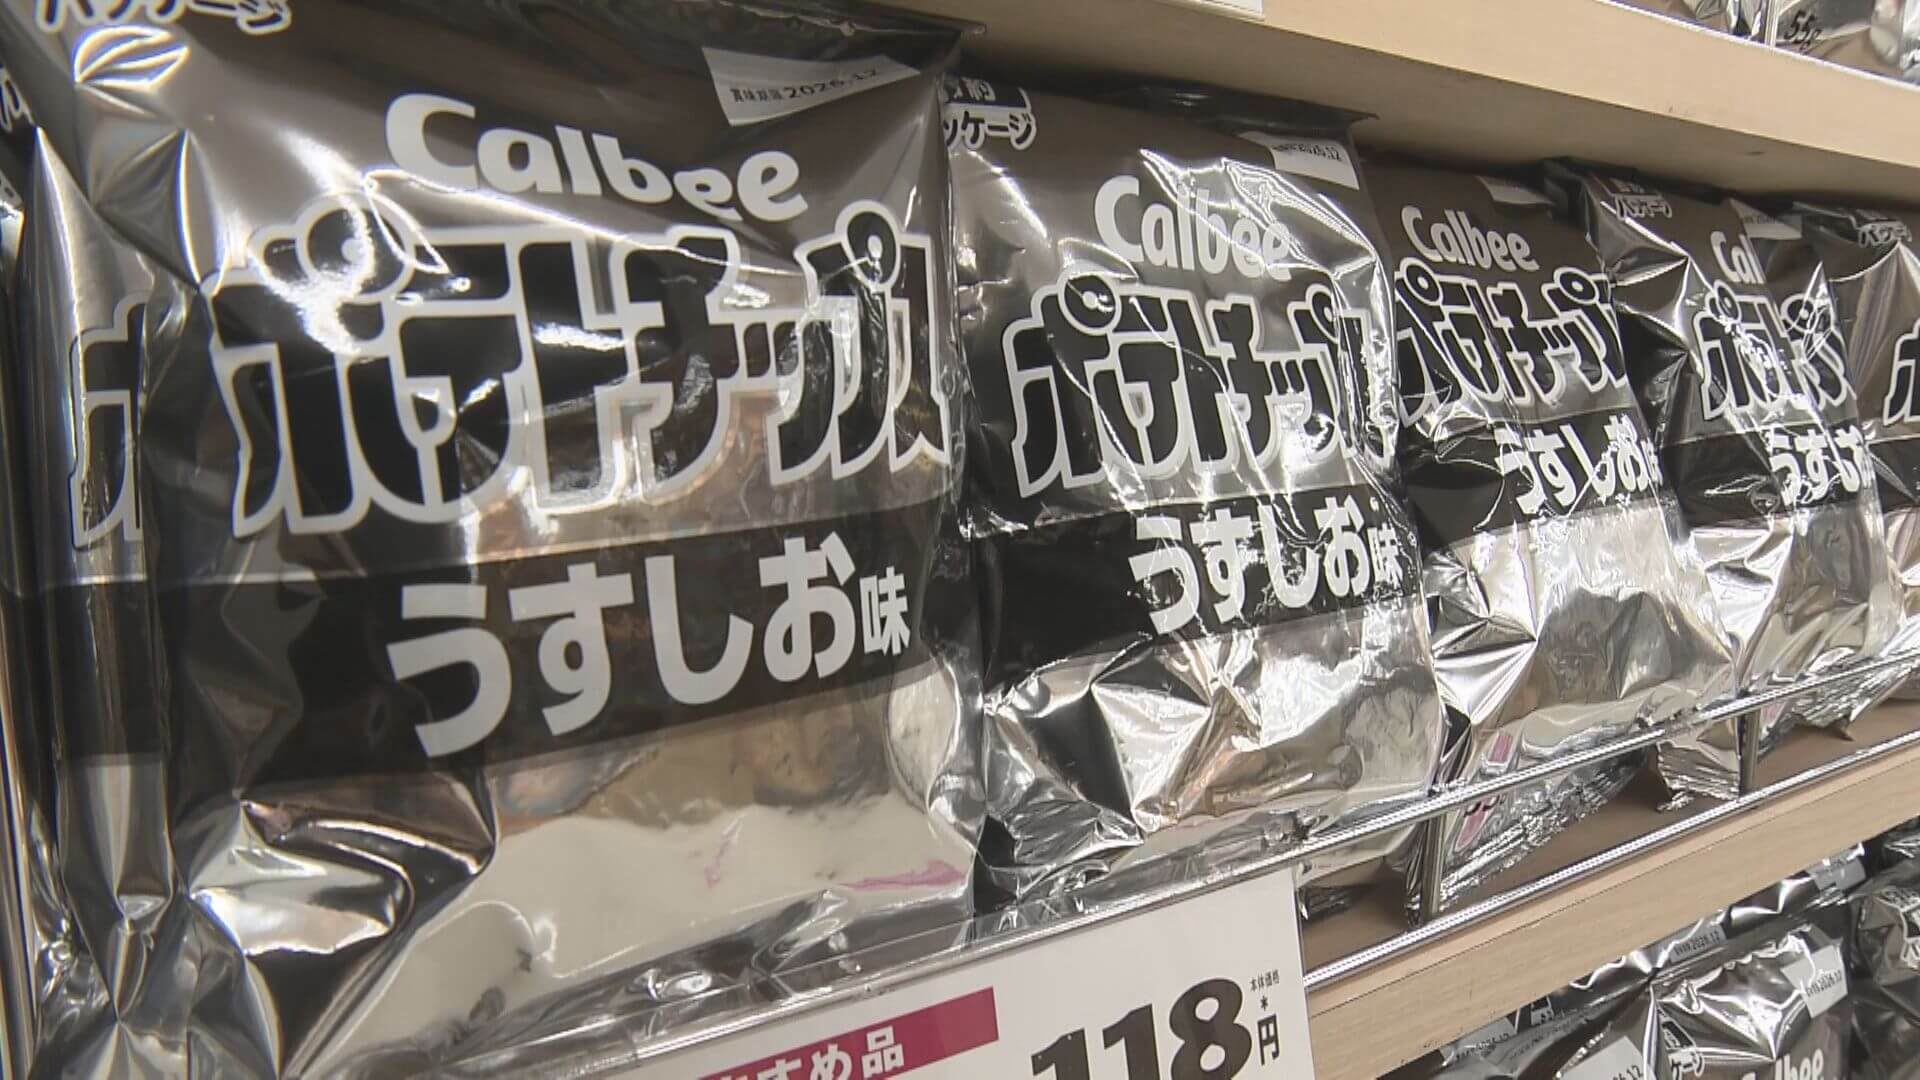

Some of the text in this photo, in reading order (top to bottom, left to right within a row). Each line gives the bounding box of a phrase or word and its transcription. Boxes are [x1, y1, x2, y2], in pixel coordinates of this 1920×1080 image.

[386, 93, 808, 222] Calbee
[1094, 175, 1291, 280] Calbee
[1401, 206, 1540, 272] Calbee
[1710, 231, 1767, 285] Cal
[202, 200, 952, 538] ポテトチップス
[1394, 257, 1628, 428] ポテトチップ
[1128, 494, 1403, 635] うすしお味
[386, 532, 911, 758] うすしお味
[1257, 1013, 1280, 1067] 円
